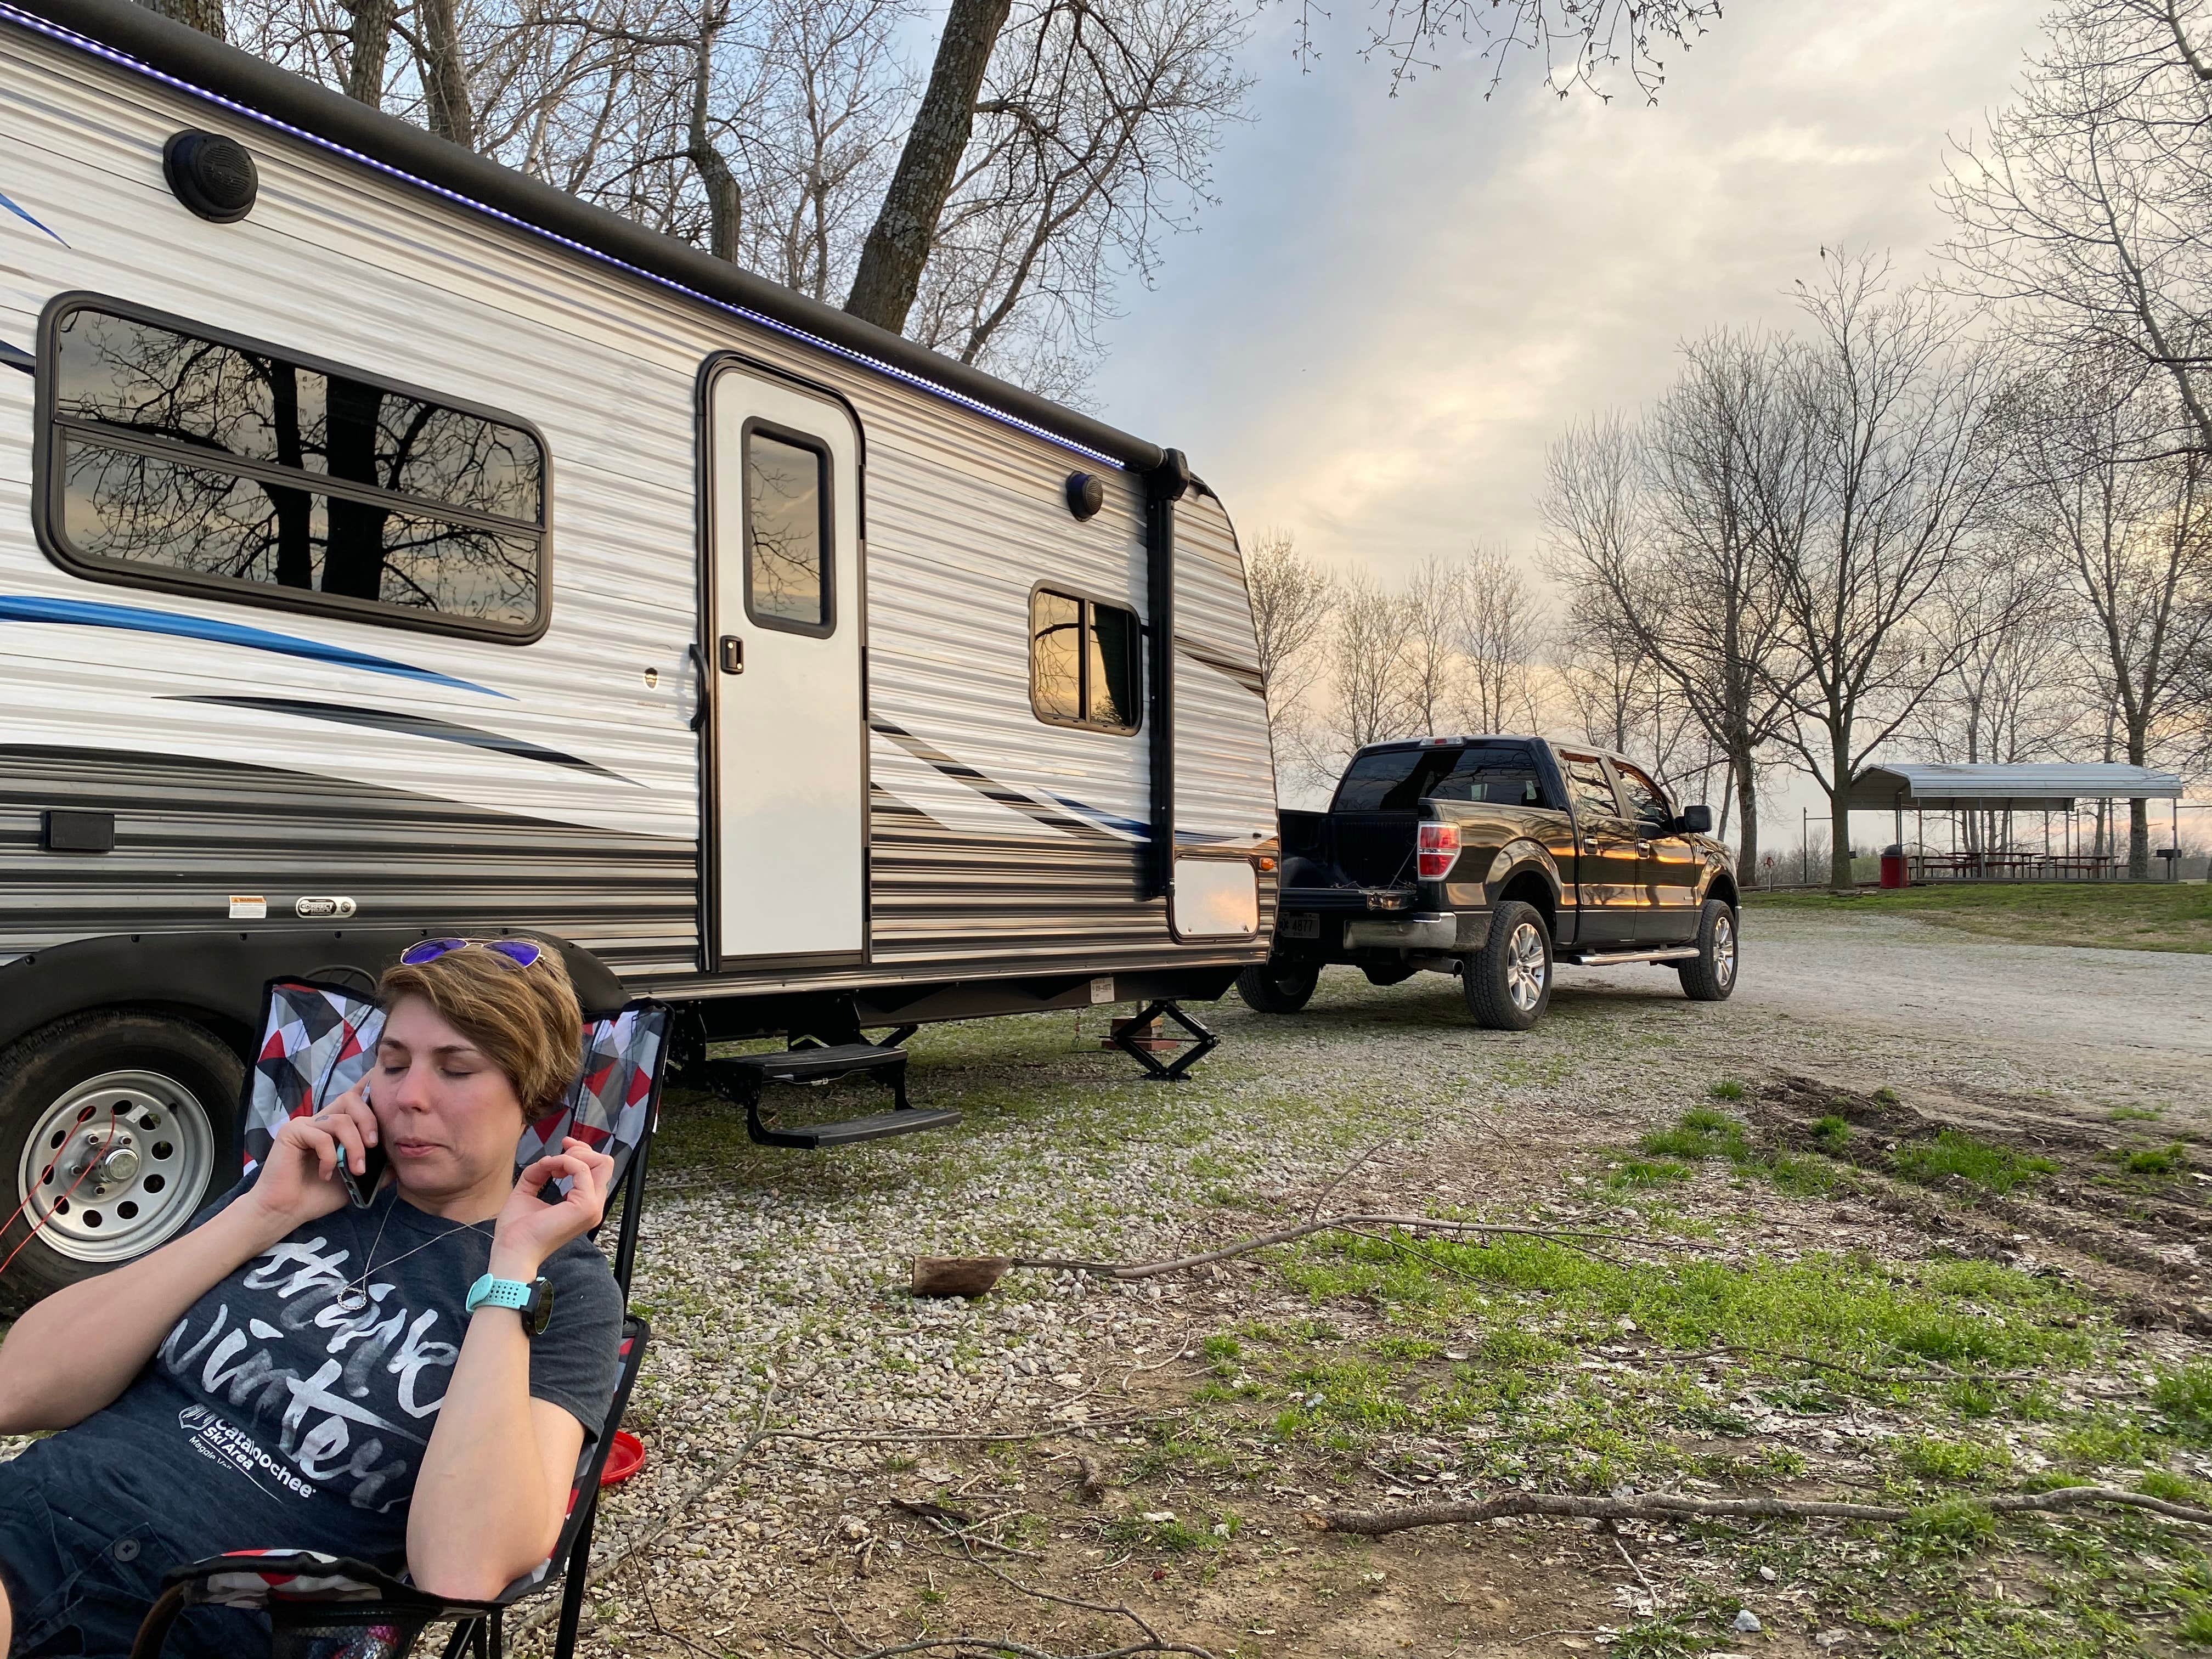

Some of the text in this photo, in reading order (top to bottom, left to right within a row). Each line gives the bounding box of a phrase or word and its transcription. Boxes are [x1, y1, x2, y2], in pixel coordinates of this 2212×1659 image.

[1292, 919, 1313, 932] 4877
[203, 1426, 228, 1445] Ski
[221, 1443, 254, 1470] Area
[215, 1418, 313, 1498] Cataloochee
